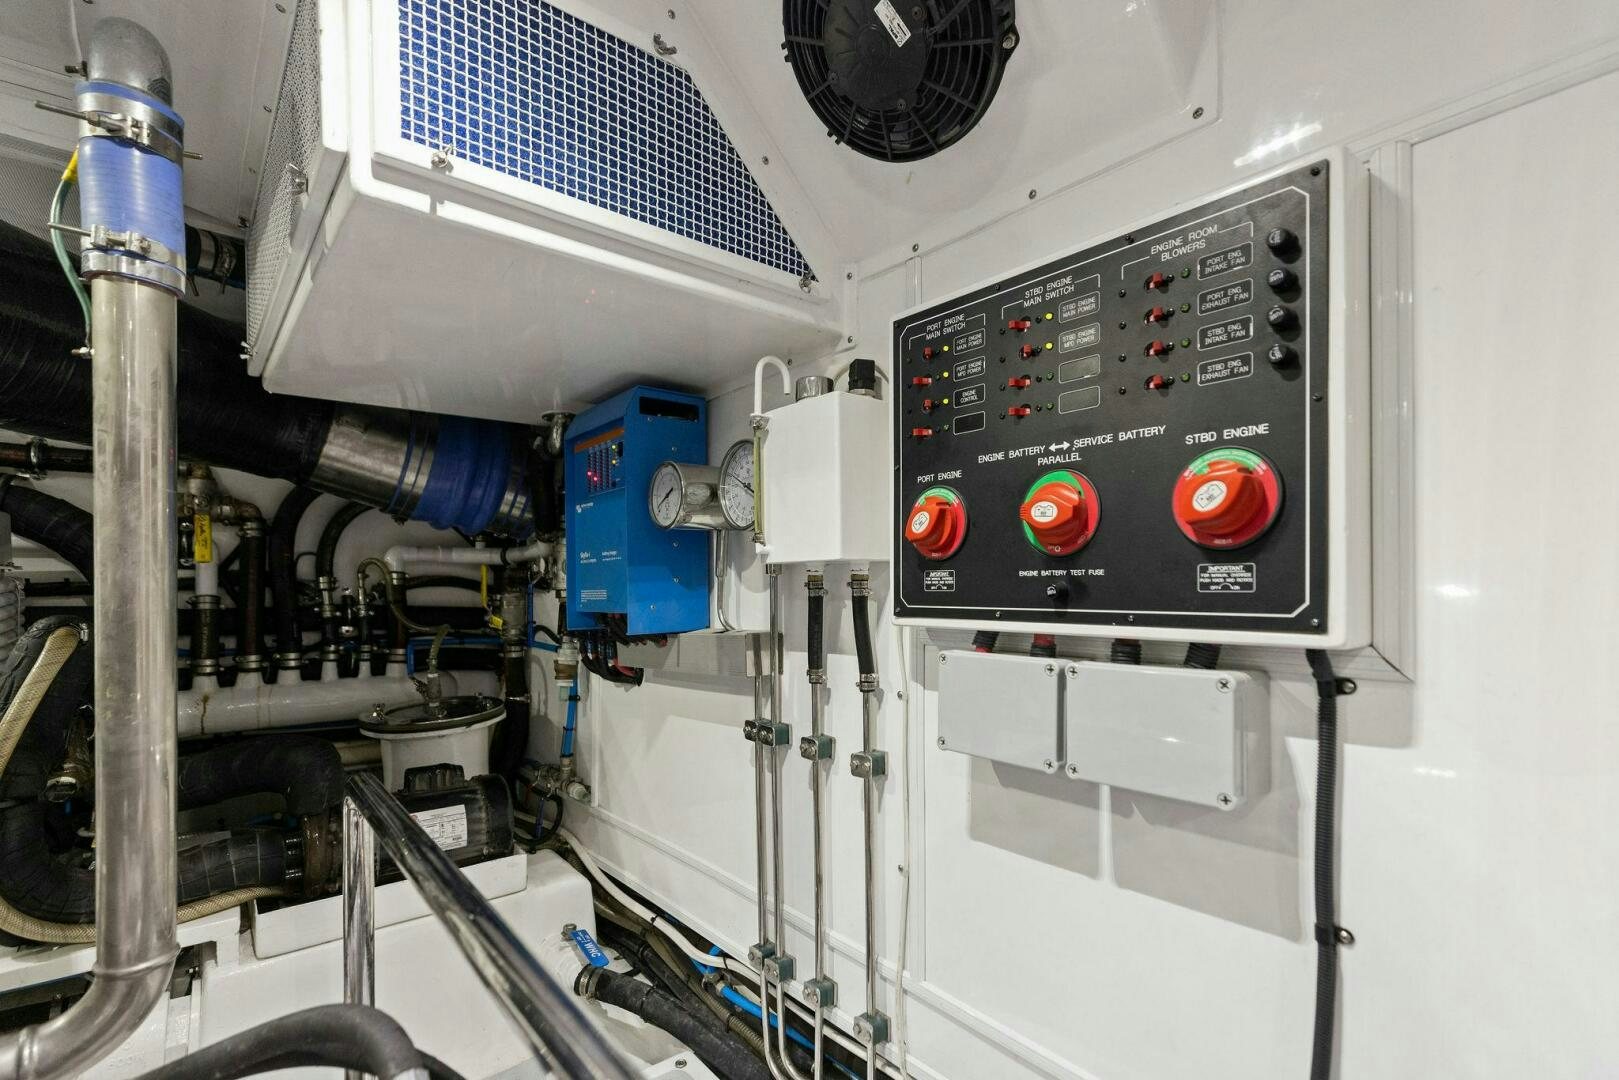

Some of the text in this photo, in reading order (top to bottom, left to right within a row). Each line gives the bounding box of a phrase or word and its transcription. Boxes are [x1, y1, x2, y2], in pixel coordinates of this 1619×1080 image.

[1151, 224, 1218, 254] ENGINE ROOM
[1161, 240, 1206, 261] BLOWERS
[1207, 250, 1241, 266] PORT ENG
[1205, 257, 1246, 274] INTAKE FAN
[1025, 276, 1072, 298] STBD ENGINE
[1207, 287, 1241, 302] PORT ENG
[1024, 284, 1074, 308] MAIN SWITCH
[1202, 292, 1248, 310] EXHAUST FAN
[1063, 297, 1095, 312] STBD ENGINE
[1078, 303, 1096, 314] POWER
[926, 314, 964, 332] PORT ENGINE
[1207, 323, 1241, 337] STBD ENG
[926, 322, 965, 340] MAIN SWITCH
[1063, 328, 1096, 342] STBD ENGINE
[1205, 330, 1246, 345] INTAKE FAN
[1077, 335, 1094, 344] POWER
[1201, 366, 1249, 381] EXHAUST FAN
[1207, 360, 1241, 372] STBD ENG
[961, 395, 978, 403] CONTROL
[1185, 423, 1269, 445] STBD ENGINE
[978, 425, 1166, 464] ENGINE BATTERY SERVICE BATTERY
[1038, 453, 1082, 466] PARALLEL
[917, 470, 962, 484] PORT ENGINE
